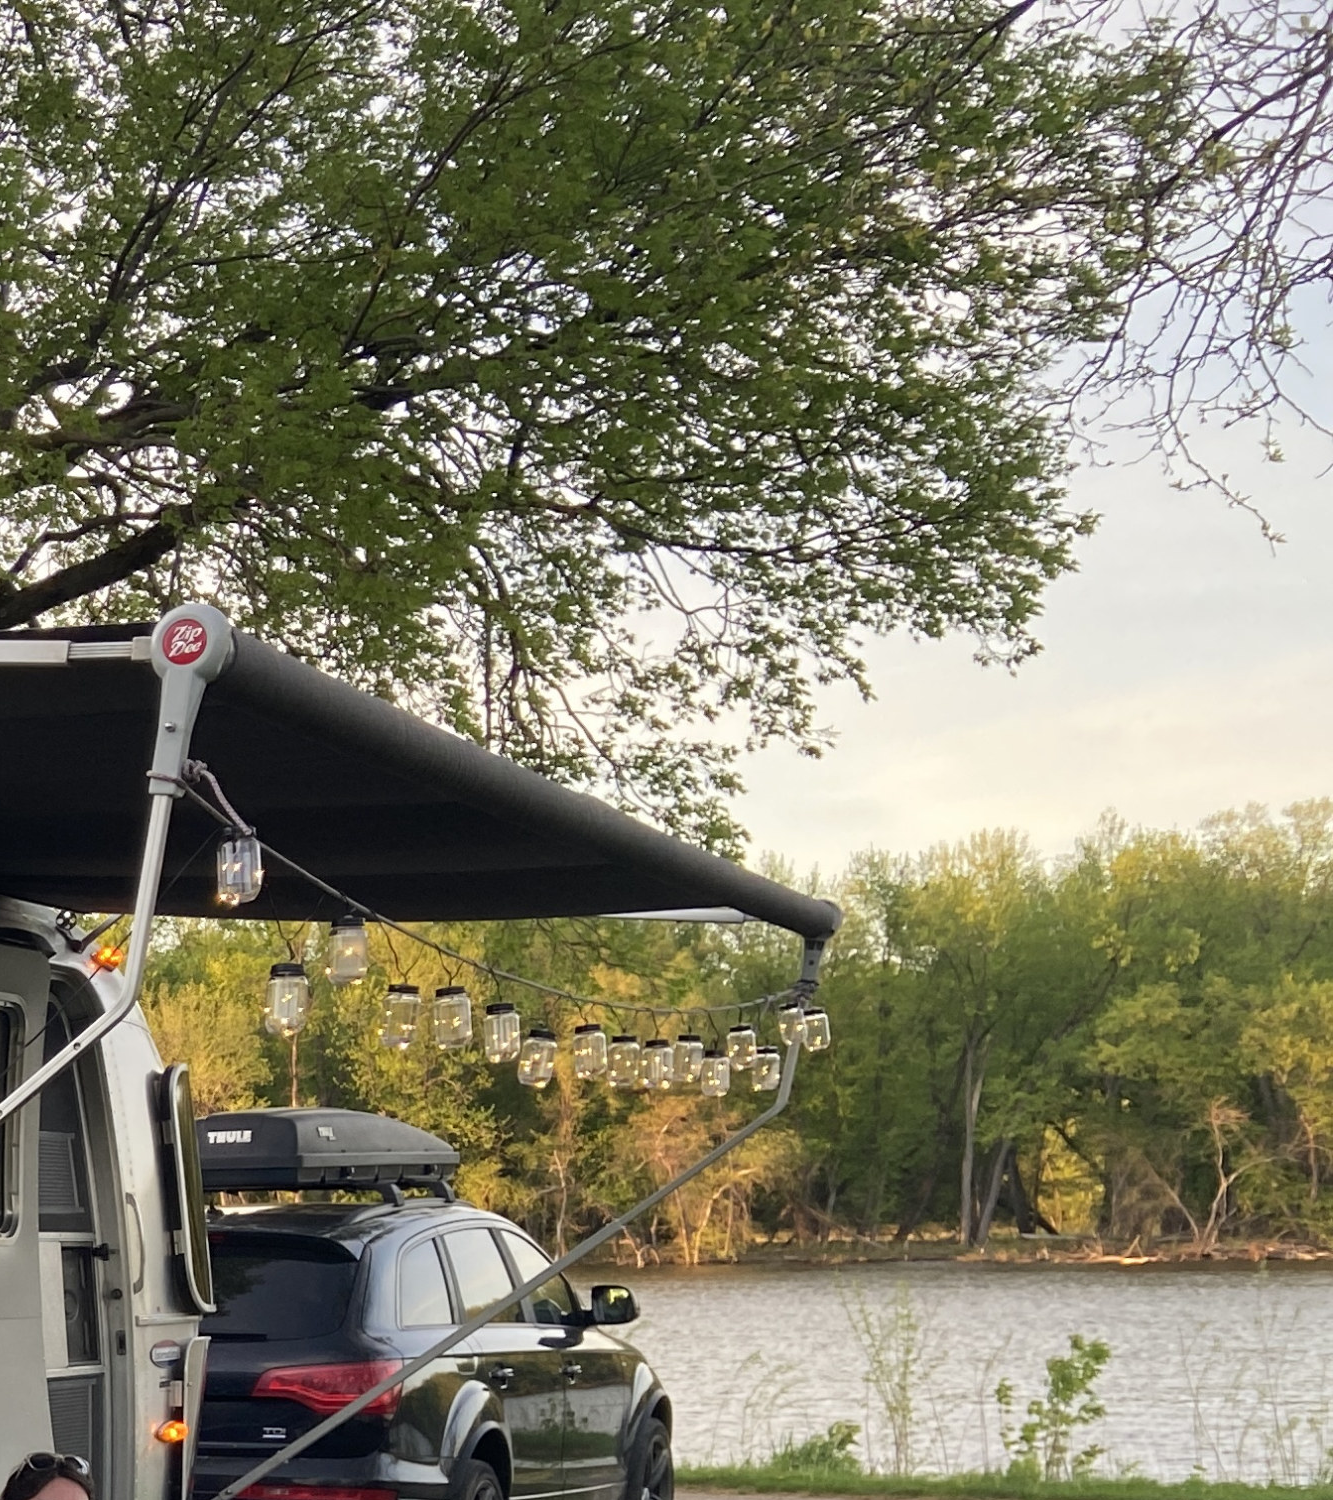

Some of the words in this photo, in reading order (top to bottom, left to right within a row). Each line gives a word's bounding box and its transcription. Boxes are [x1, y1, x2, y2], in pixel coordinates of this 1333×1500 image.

[171, 625, 203, 643] Zip
[168, 640, 203, 658] Dee
[207, 1130, 252, 1144] THULE
